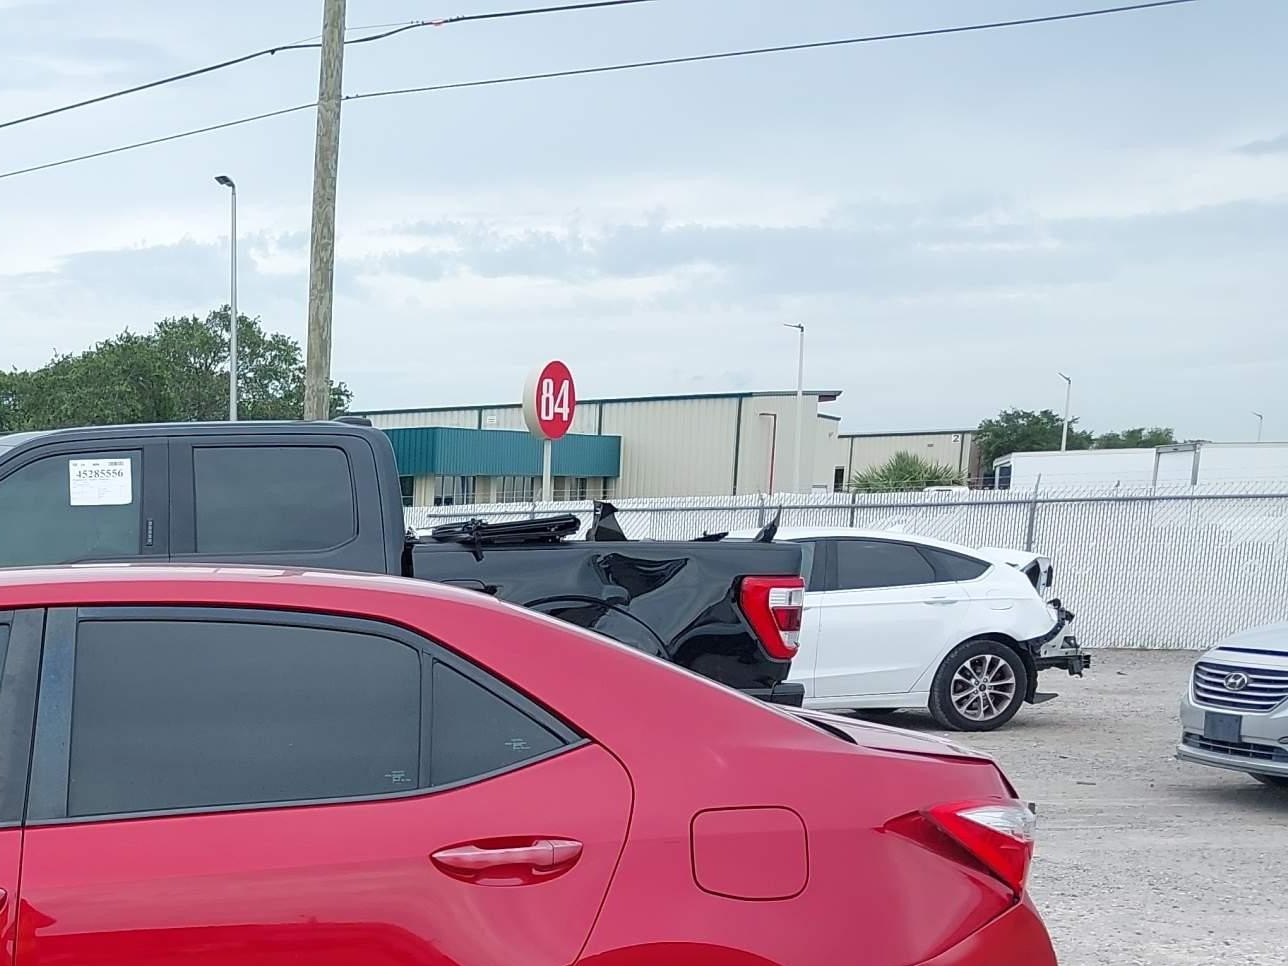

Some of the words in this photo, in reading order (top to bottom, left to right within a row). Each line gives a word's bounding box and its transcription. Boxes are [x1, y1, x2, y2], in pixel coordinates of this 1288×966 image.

[540, 378, 570, 421] 84
[952, 434, 960, 443] 2
[75, 469, 124, 479] 45285556
